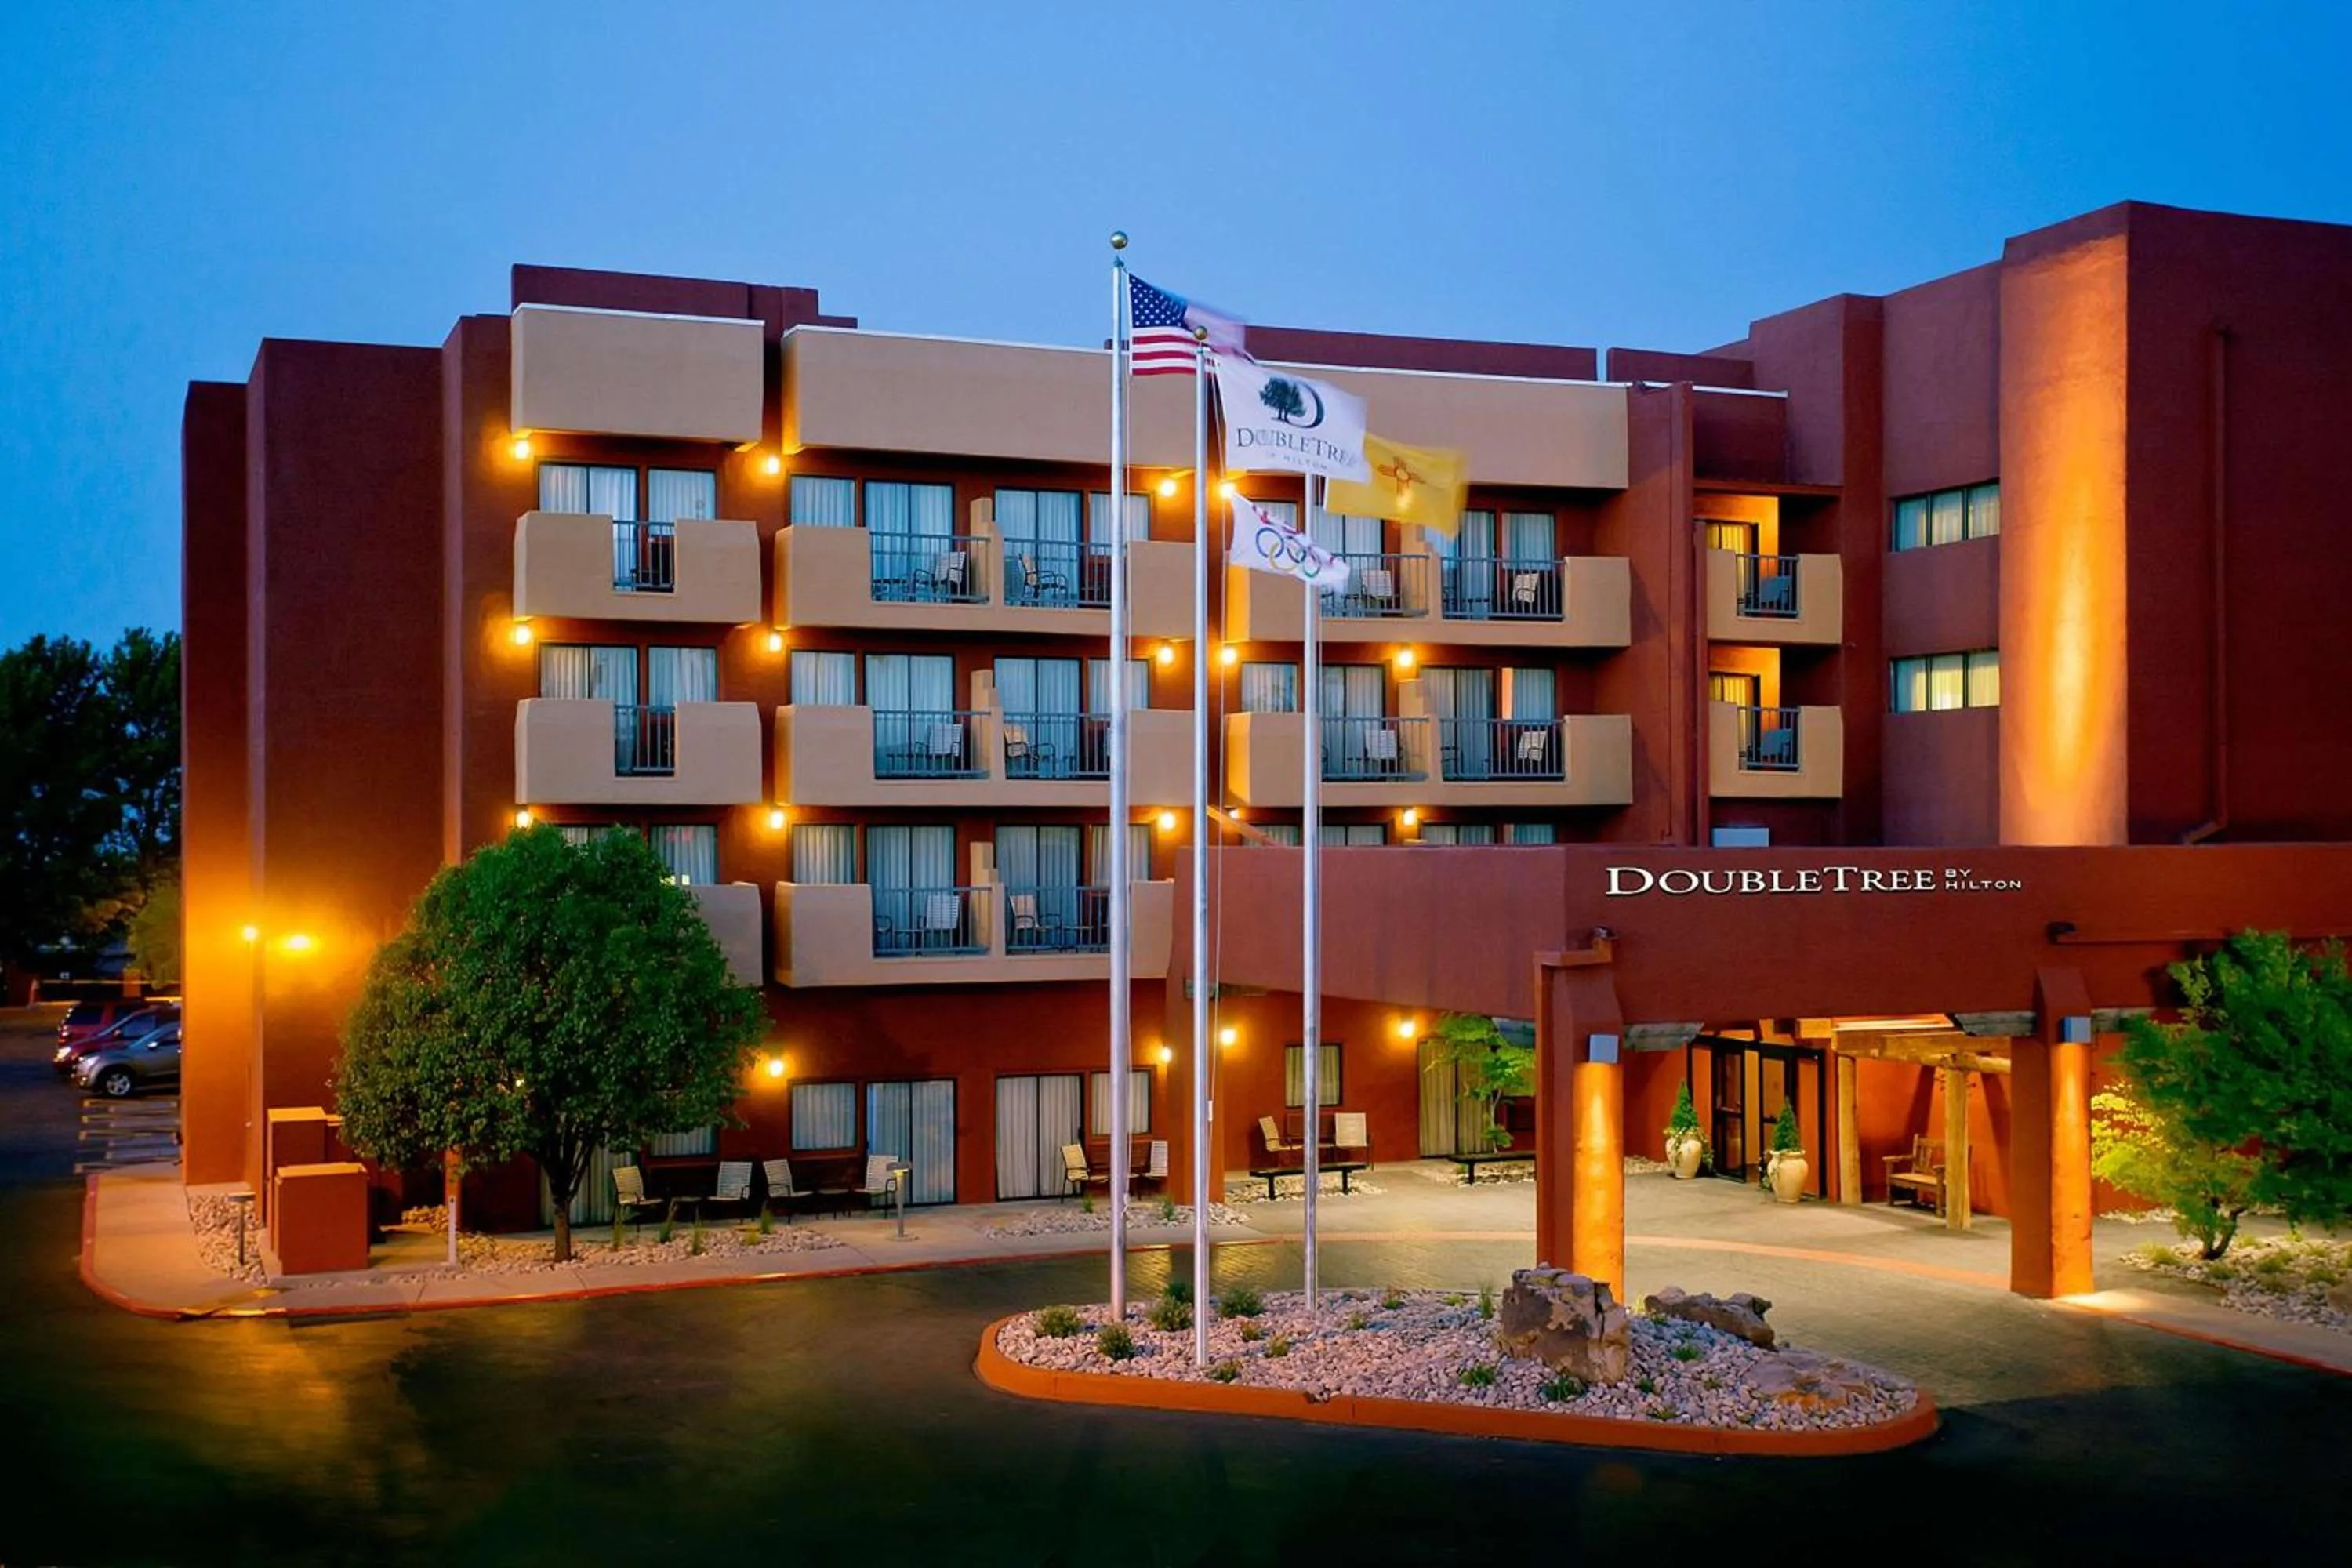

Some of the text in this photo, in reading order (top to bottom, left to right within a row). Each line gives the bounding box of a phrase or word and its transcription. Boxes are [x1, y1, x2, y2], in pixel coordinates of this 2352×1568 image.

[1945, 868, 1972, 877] BY
[1605, 866, 1936, 895] DOUBLETREE
[1945, 880, 2022, 890] HILTON
